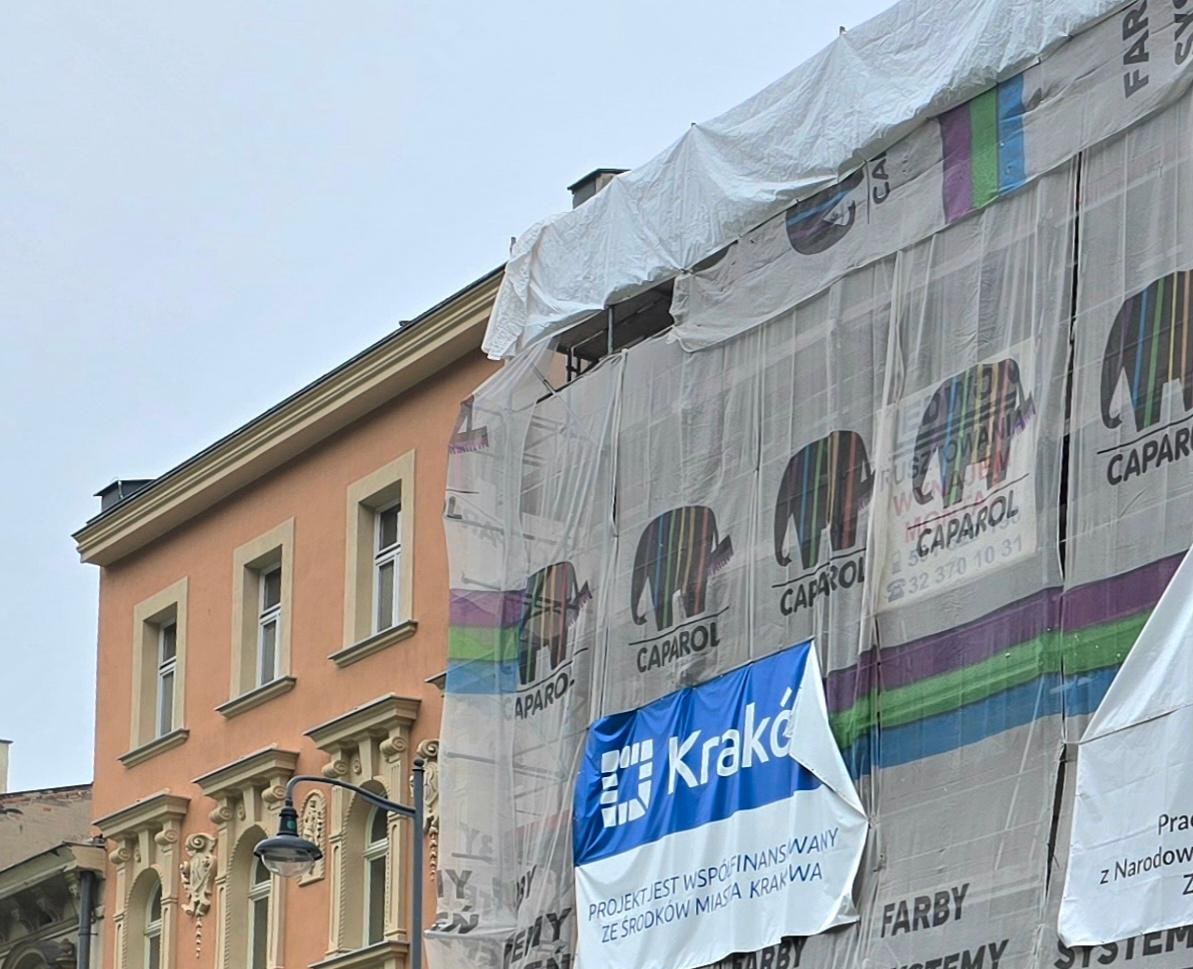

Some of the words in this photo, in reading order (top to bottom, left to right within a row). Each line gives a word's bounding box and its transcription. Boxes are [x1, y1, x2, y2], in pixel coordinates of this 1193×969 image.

[917, 490, 1018, 558] CAPAROL
[780, 556, 865, 616] CAPAROL
[636, 622, 720, 673] CAPAROL
[668, 687, 796, 795] Krakó
[589, 887, 647, 921] PROJEKT
[648, 877, 680, 906] JEST
[1100, 867, 1110, 884] z
[601, 925, 617, 943] ZE
[621, 896, 692, 938] ŚRODKÓW
[881, 882, 970, 938] FARBY
